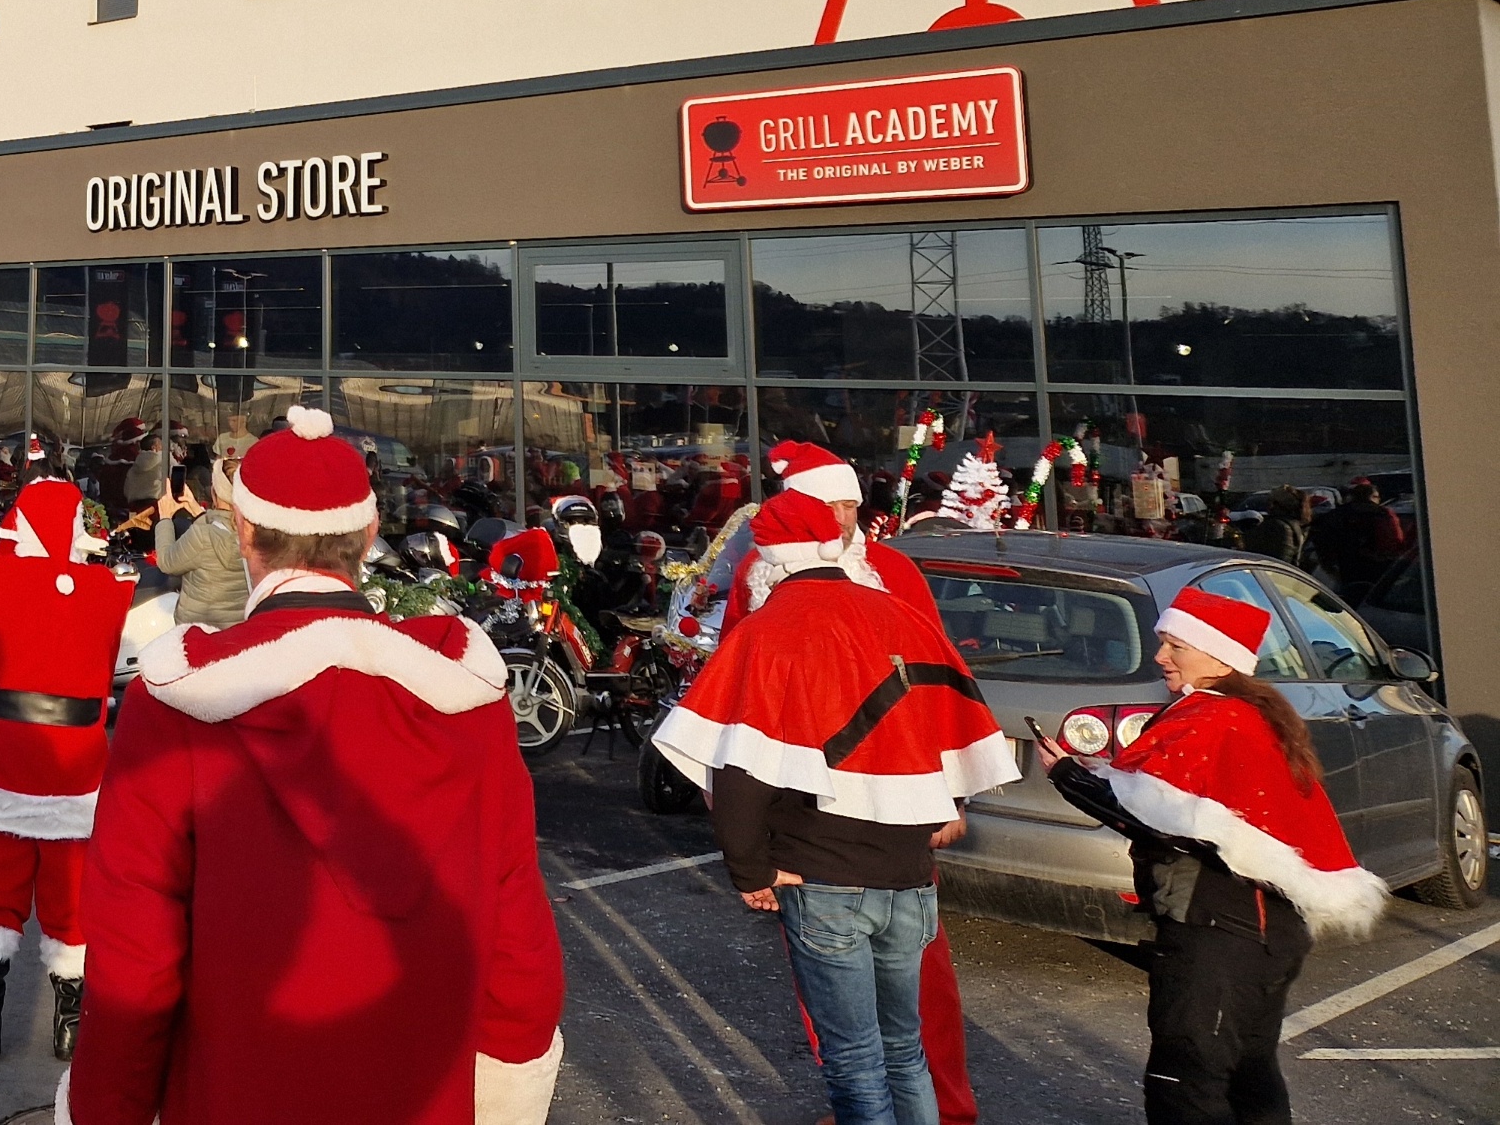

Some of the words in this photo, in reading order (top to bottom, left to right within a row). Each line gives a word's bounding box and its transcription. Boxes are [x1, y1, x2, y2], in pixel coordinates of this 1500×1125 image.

[759, 115, 840, 153] GRILL
[844, 99, 999, 146] ACADEMY
[86, 165, 246, 231] ORIGINAL
[257, 152, 386, 222] STORE
[777, 168, 808, 182] THE
[813, 162, 892, 179] ORIGINAL
[897, 160, 917, 174] BY
[923, 155, 985, 172] WEBER
